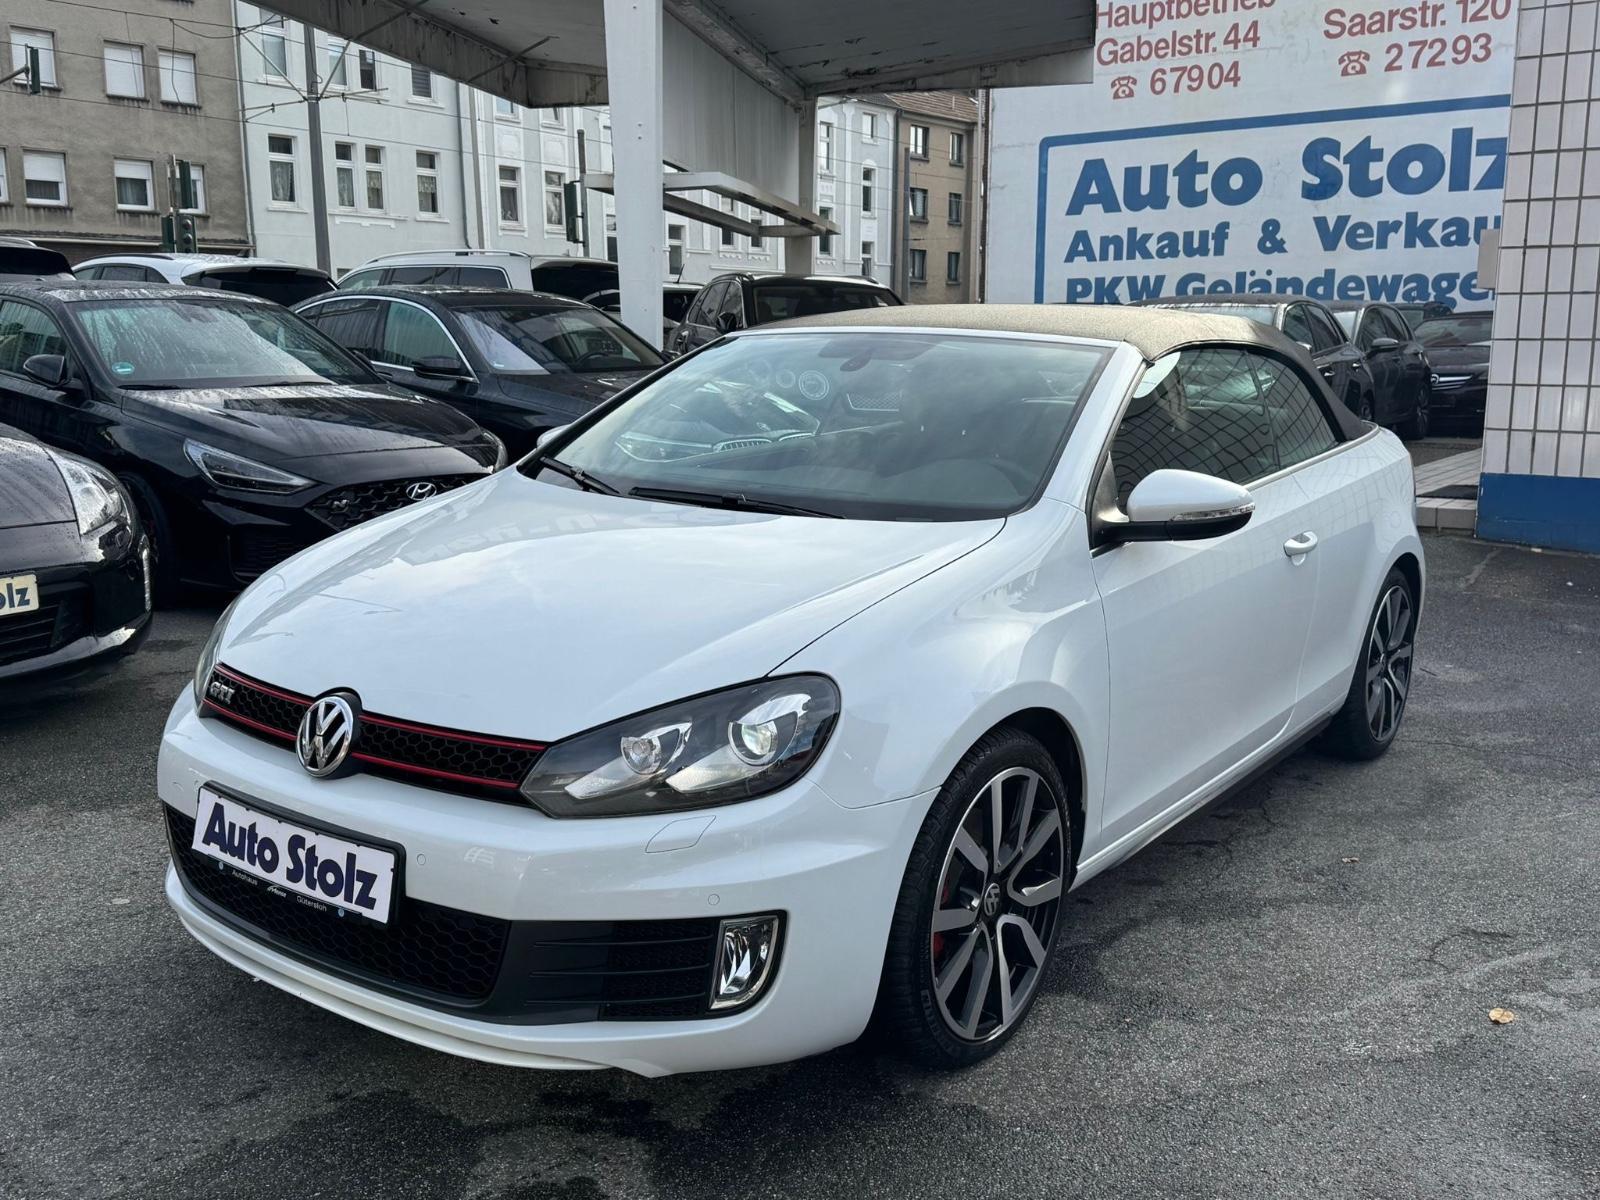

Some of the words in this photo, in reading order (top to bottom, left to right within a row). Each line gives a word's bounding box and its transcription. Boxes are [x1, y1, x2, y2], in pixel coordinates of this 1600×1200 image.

[1096, 0, 1276, 29] Hauptbetre
[1323, 1, 1447, 40] Saarstr.
[1456, 0, 1511, 23] 120
[1096, 29, 1217, 66] Gabelstr.
[1223, 20, 1261, 50] 44
[1065, 149, 1263, 216] Auto
[1301, 127, 1508, 200] Stolz
[1064, 221, 1230, 263] Ankauf
[1257, 218, 1288, 255] &
[1067, 274, 1166, 305] PKW
[1175, 268, 1496, 312] Geländewage
[209, 681, 235, 705] GTI
[202, 802, 280, 874] Auto
[286, 833, 378, 911] Stolz
